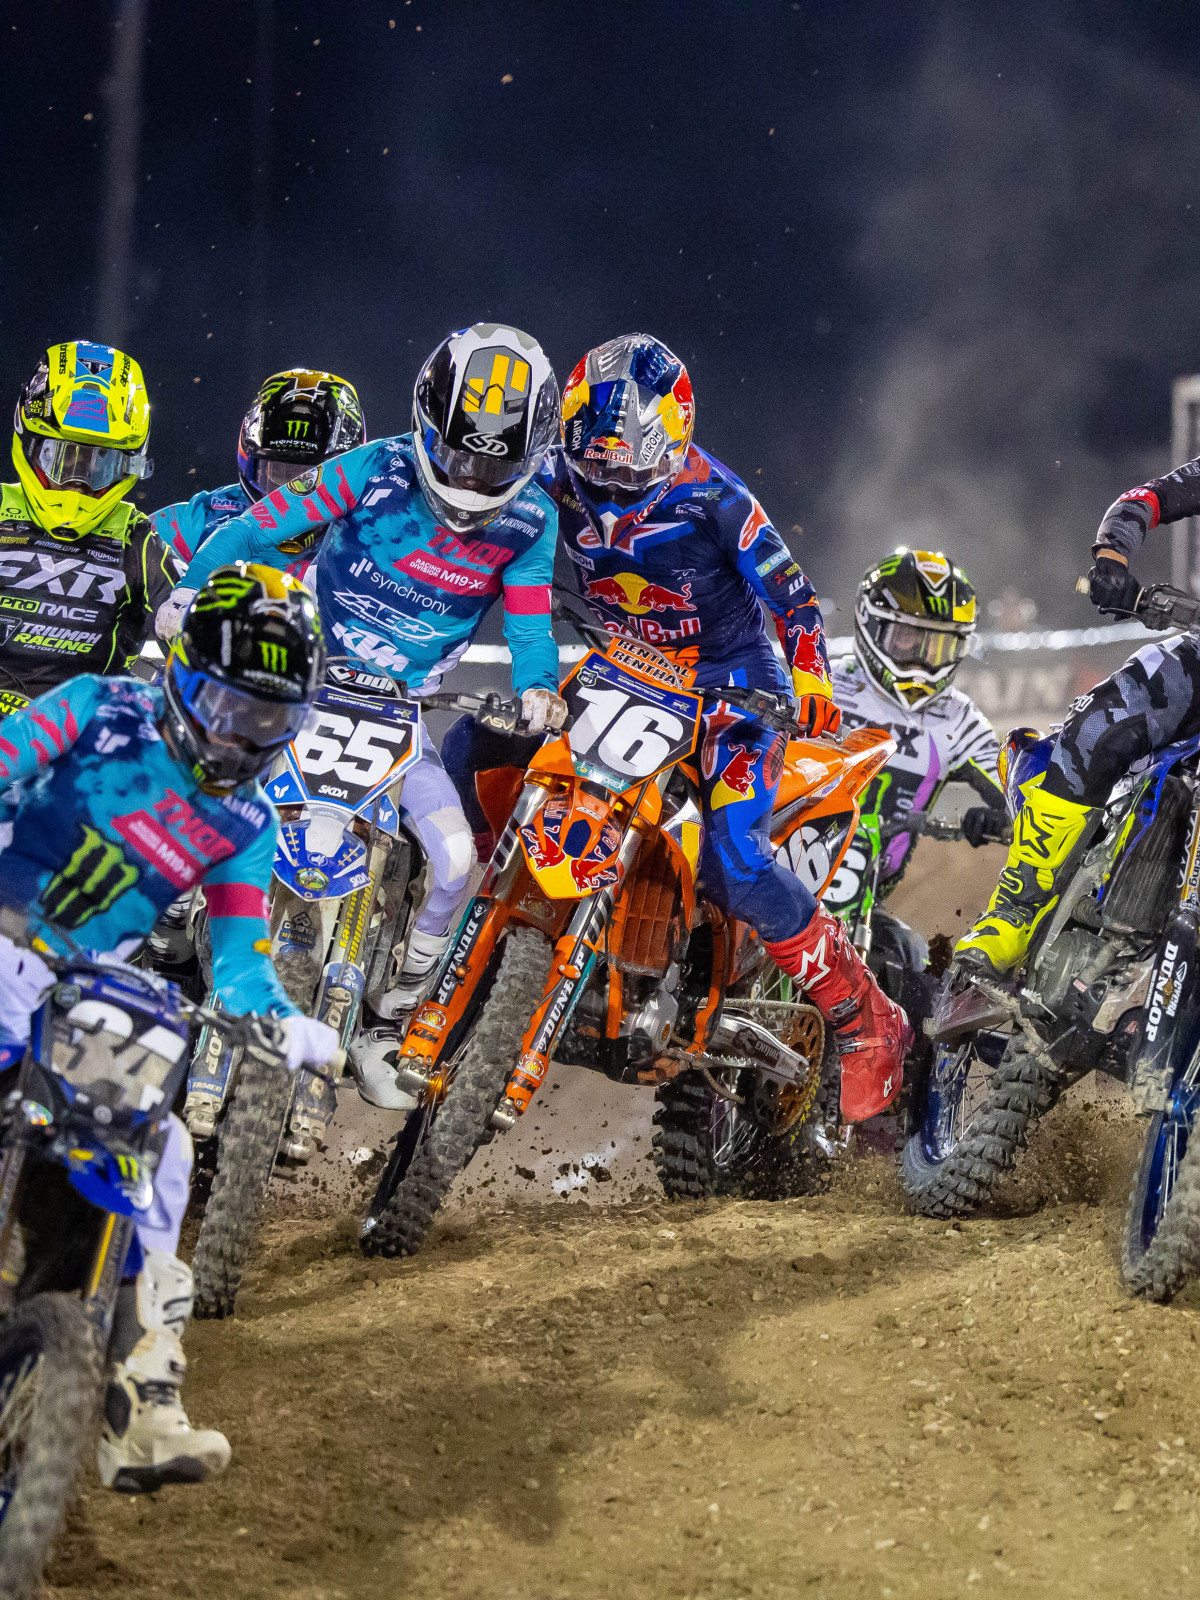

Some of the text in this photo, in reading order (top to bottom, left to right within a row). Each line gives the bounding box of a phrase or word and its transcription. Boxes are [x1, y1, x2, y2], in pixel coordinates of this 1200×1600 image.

[269, 439, 318, 450] MONSTER
[573, 419, 583, 451] AIROH
[640, 430, 664, 463] AIROH
[584, 448, 634, 465] Red Bull
[87, 550, 120, 563] TRIUMPH
[427, 526, 515, 569] THOR
[0, 550, 126, 604] FXR
[409, 562, 439, 577] DIVISION
[416, 559, 441, 573] RACING
[370, 570, 452, 617] synchrony
[1, 597, 99, 623] PRO RACE
[19, 622, 103, 644] TRIUMPH
[639, 616, 701, 644] Bull
[13, 633, 94, 653] RACING
[23, 644, 79, 656] FACTORY TEAM
[331, 622, 411, 673] KTM
[611, 650, 687, 690] RENTHAL
[616, 639, 692, 679] RENTHAL
[617, 676, 665, 701] SUPERMOTOCROSS
[326, 696, 384, 711] SUPERMOTOCROSS
[480, 712, 516, 732] ASV
[566, 687, 684, 777] 16
[293, 710, 407, 788] 65
[317, 784, 350, 800] SKDA
[153, 787, 236, 867] THOR
[1165, 979, 1183, 1018] CYCRA
[410, 1026, 440, 1045] KTM
[509, 1074, 537, 1093] KTM
